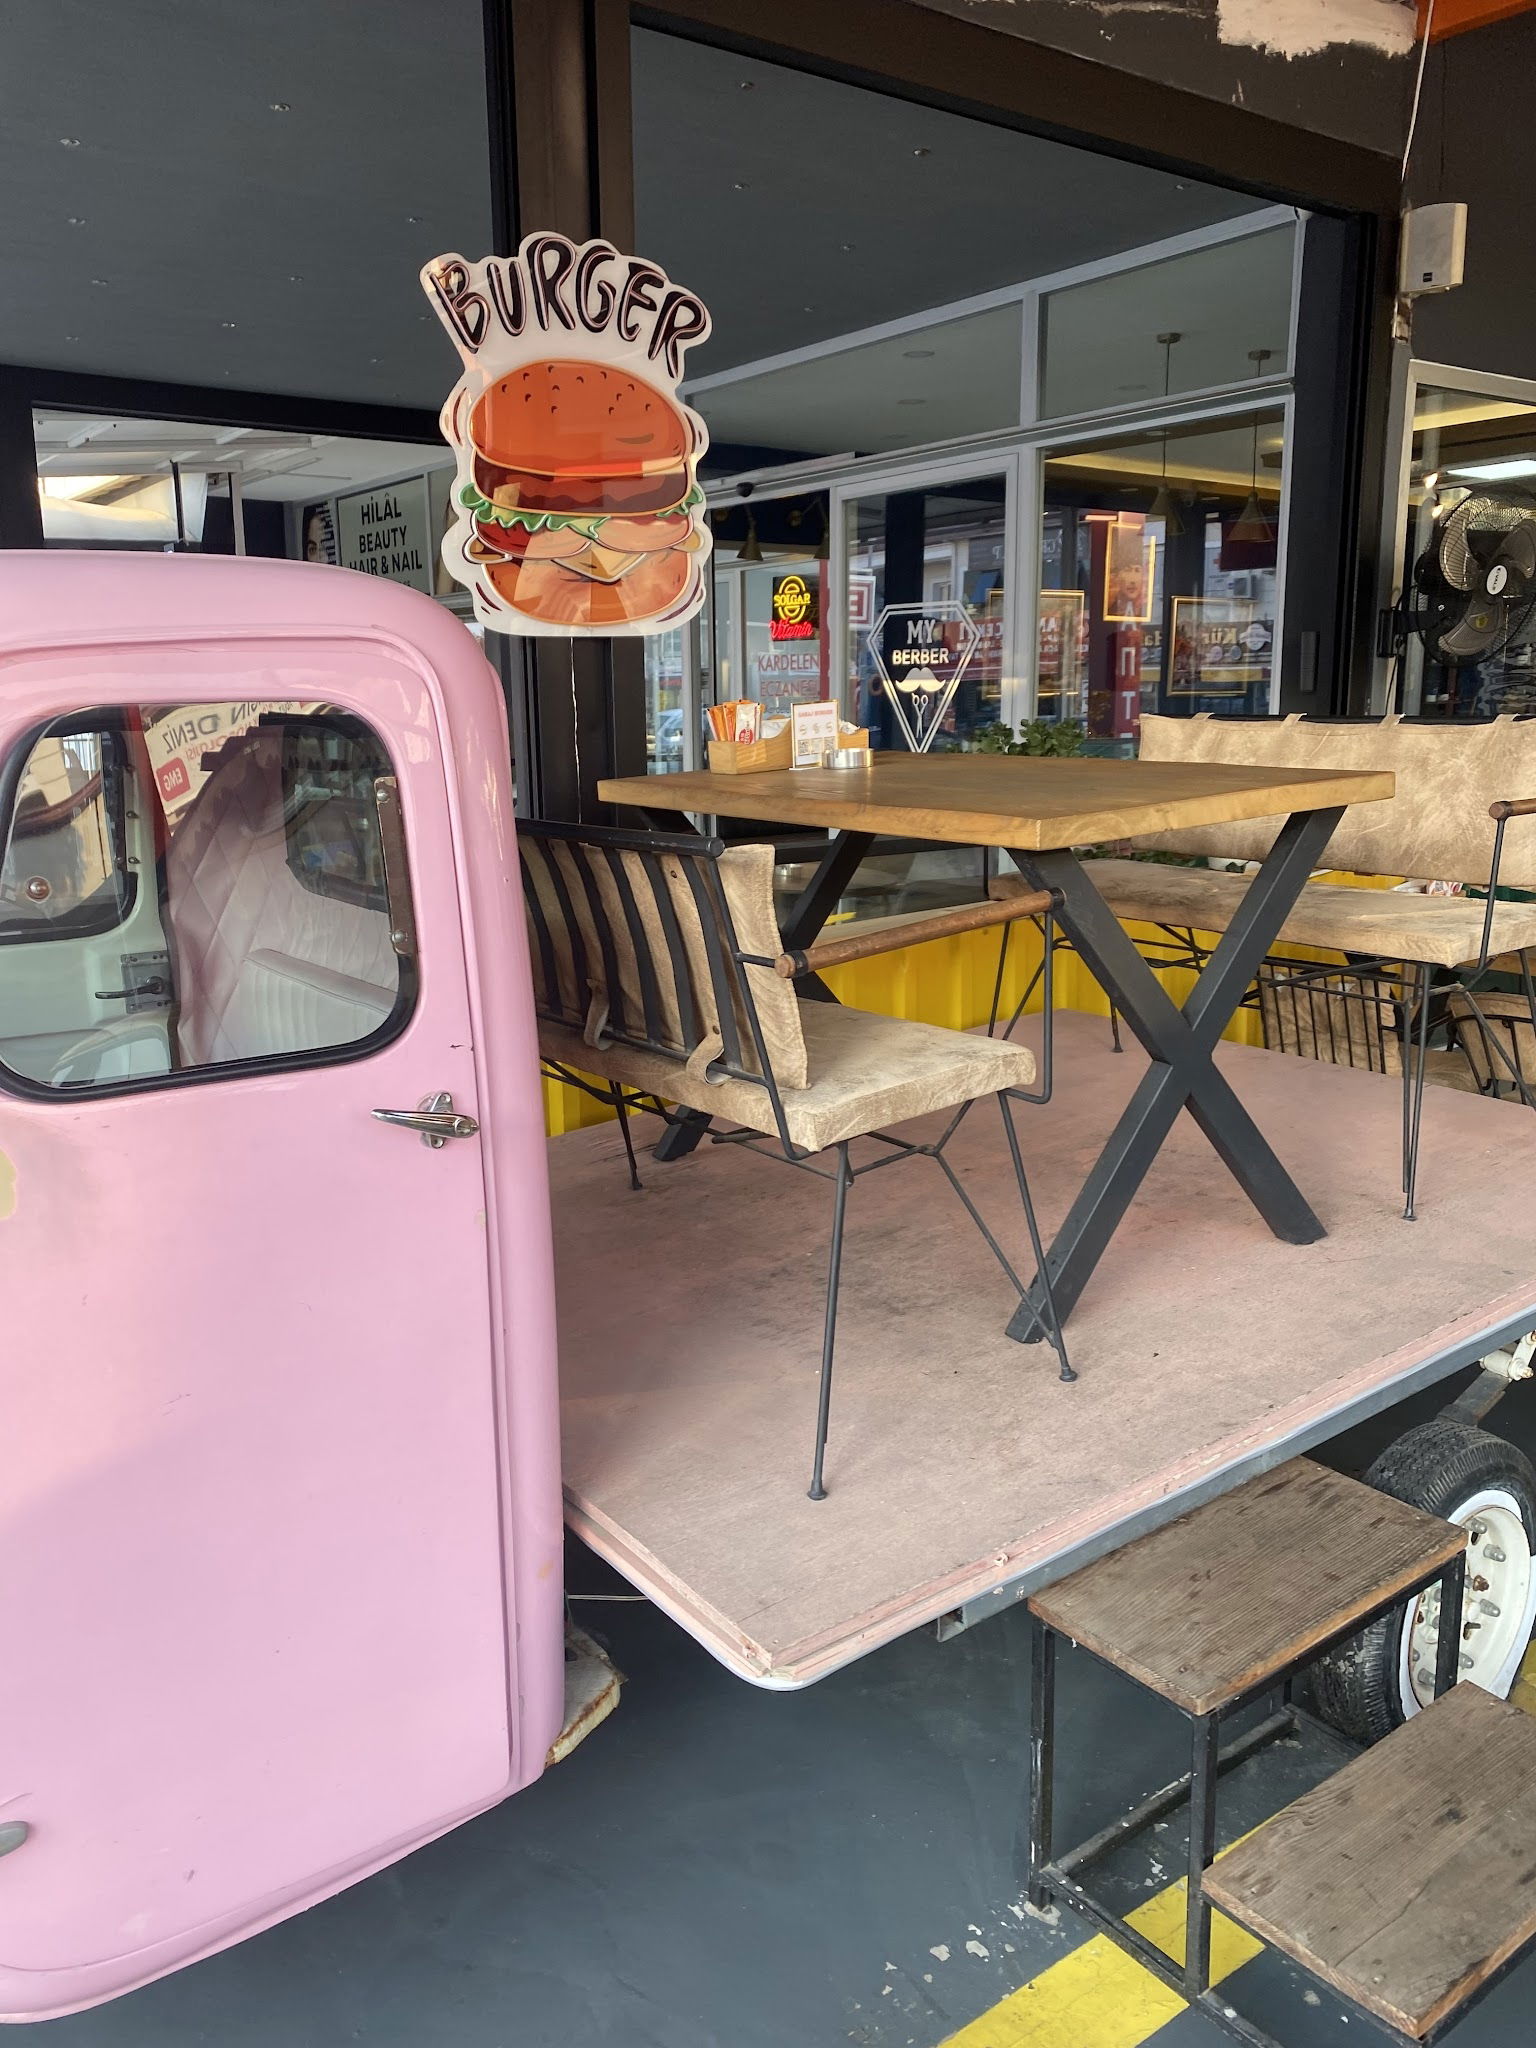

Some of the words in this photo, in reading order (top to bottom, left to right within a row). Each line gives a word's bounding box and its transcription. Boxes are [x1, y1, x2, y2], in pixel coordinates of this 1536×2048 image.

[429, 236, 707, 379] BURGER
[359, 525, 407, 554] BEAUTY
[381, 555, 389, 574] &
[392, 549, 423, 574] NAIL
[773, 593, 811, 607] SOLGAR
[768, 616, 813, 640] Vitamin
[906, 619, 936, 645] MY
[758, 653, 820, 672] KARDELEN
[892, 647, 949, 665] BERBER
[760, 679, 820, 697] ECZANES
